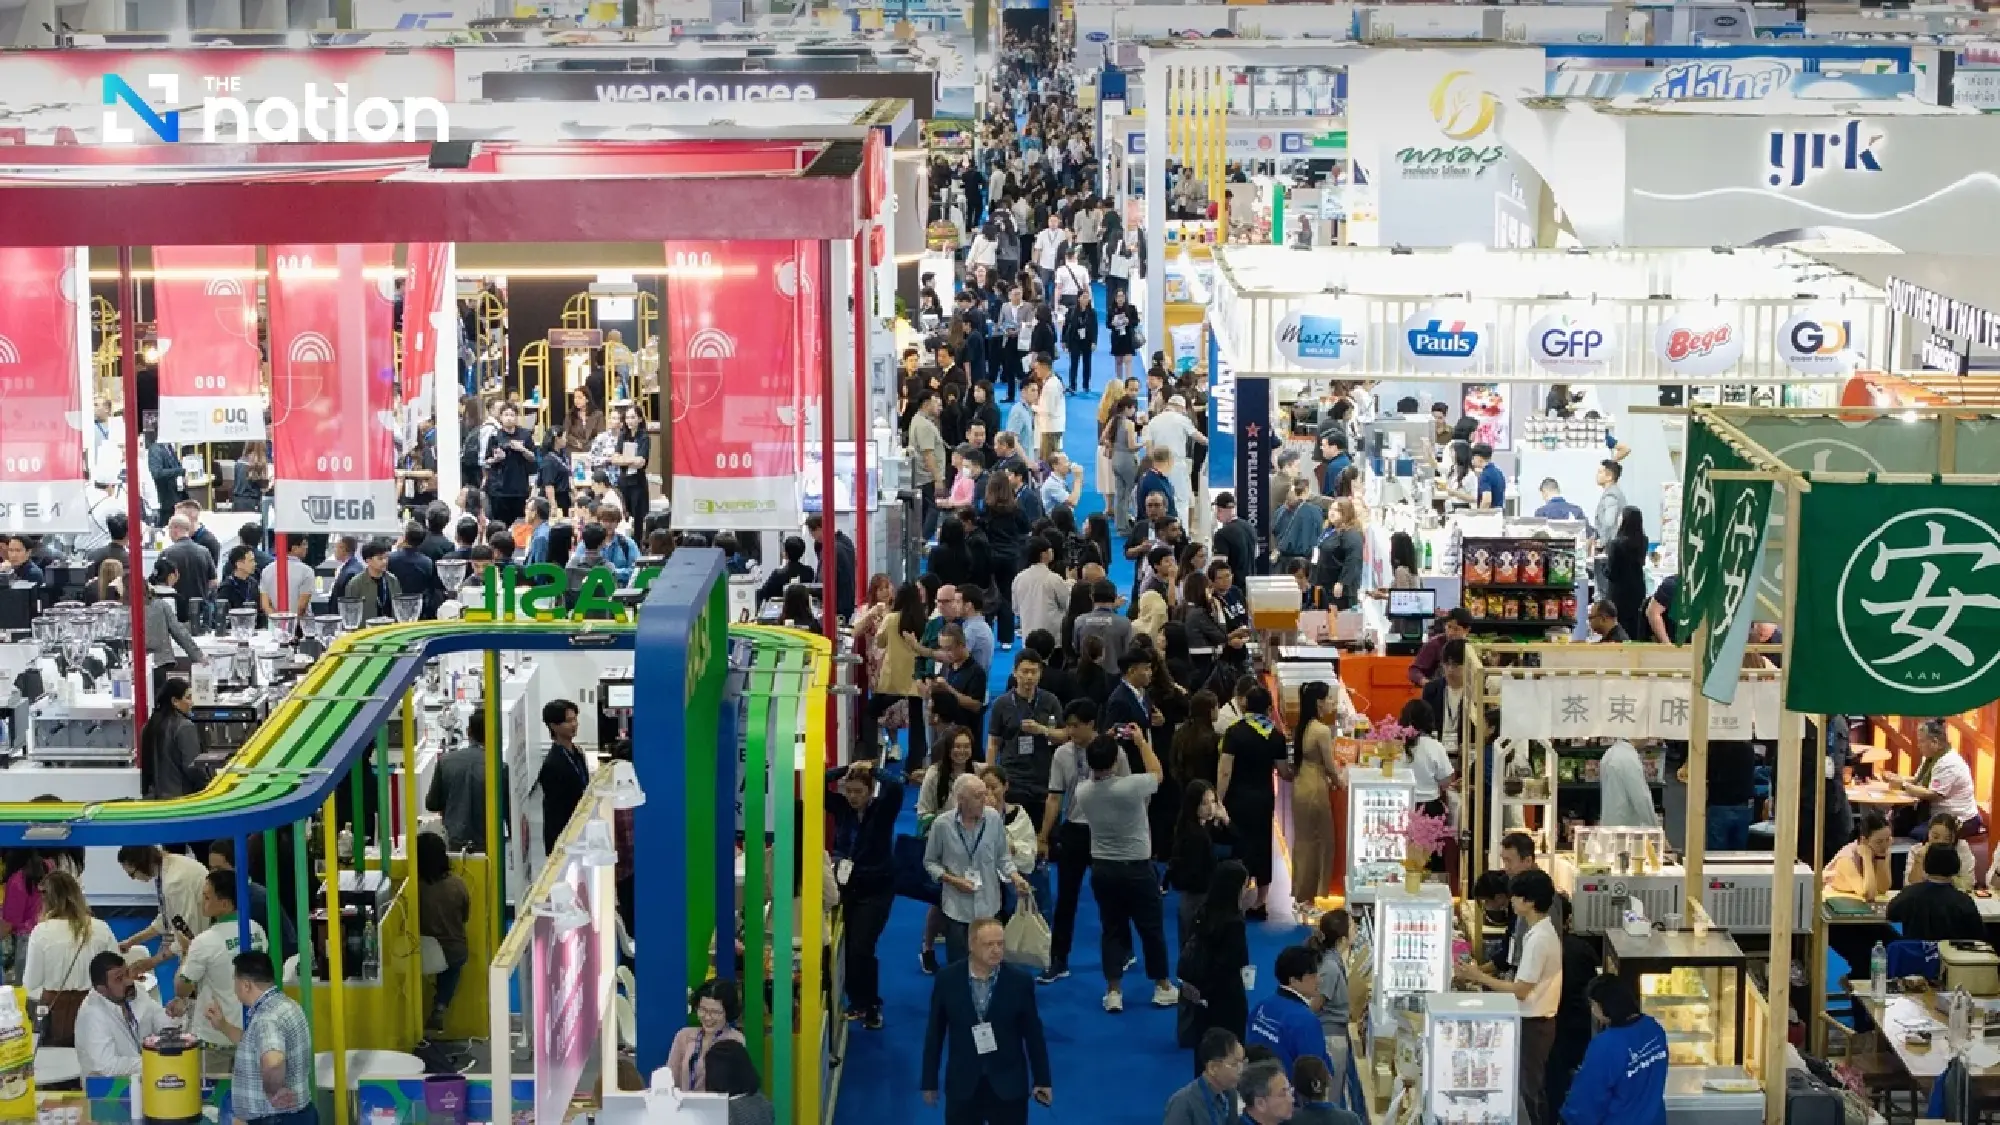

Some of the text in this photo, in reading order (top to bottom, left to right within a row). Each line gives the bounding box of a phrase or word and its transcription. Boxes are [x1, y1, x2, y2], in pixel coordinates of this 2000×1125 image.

[1416, 334, 1470, 351] Pauls
[1542, 329, 1603, 357] GFP
[1666, 324, 1732, 360] Bega
[310, 498, 375, 520] WEGA
[1860, 520, 2000, 667] 安
[1905, 670, 1941, 680] AAN
